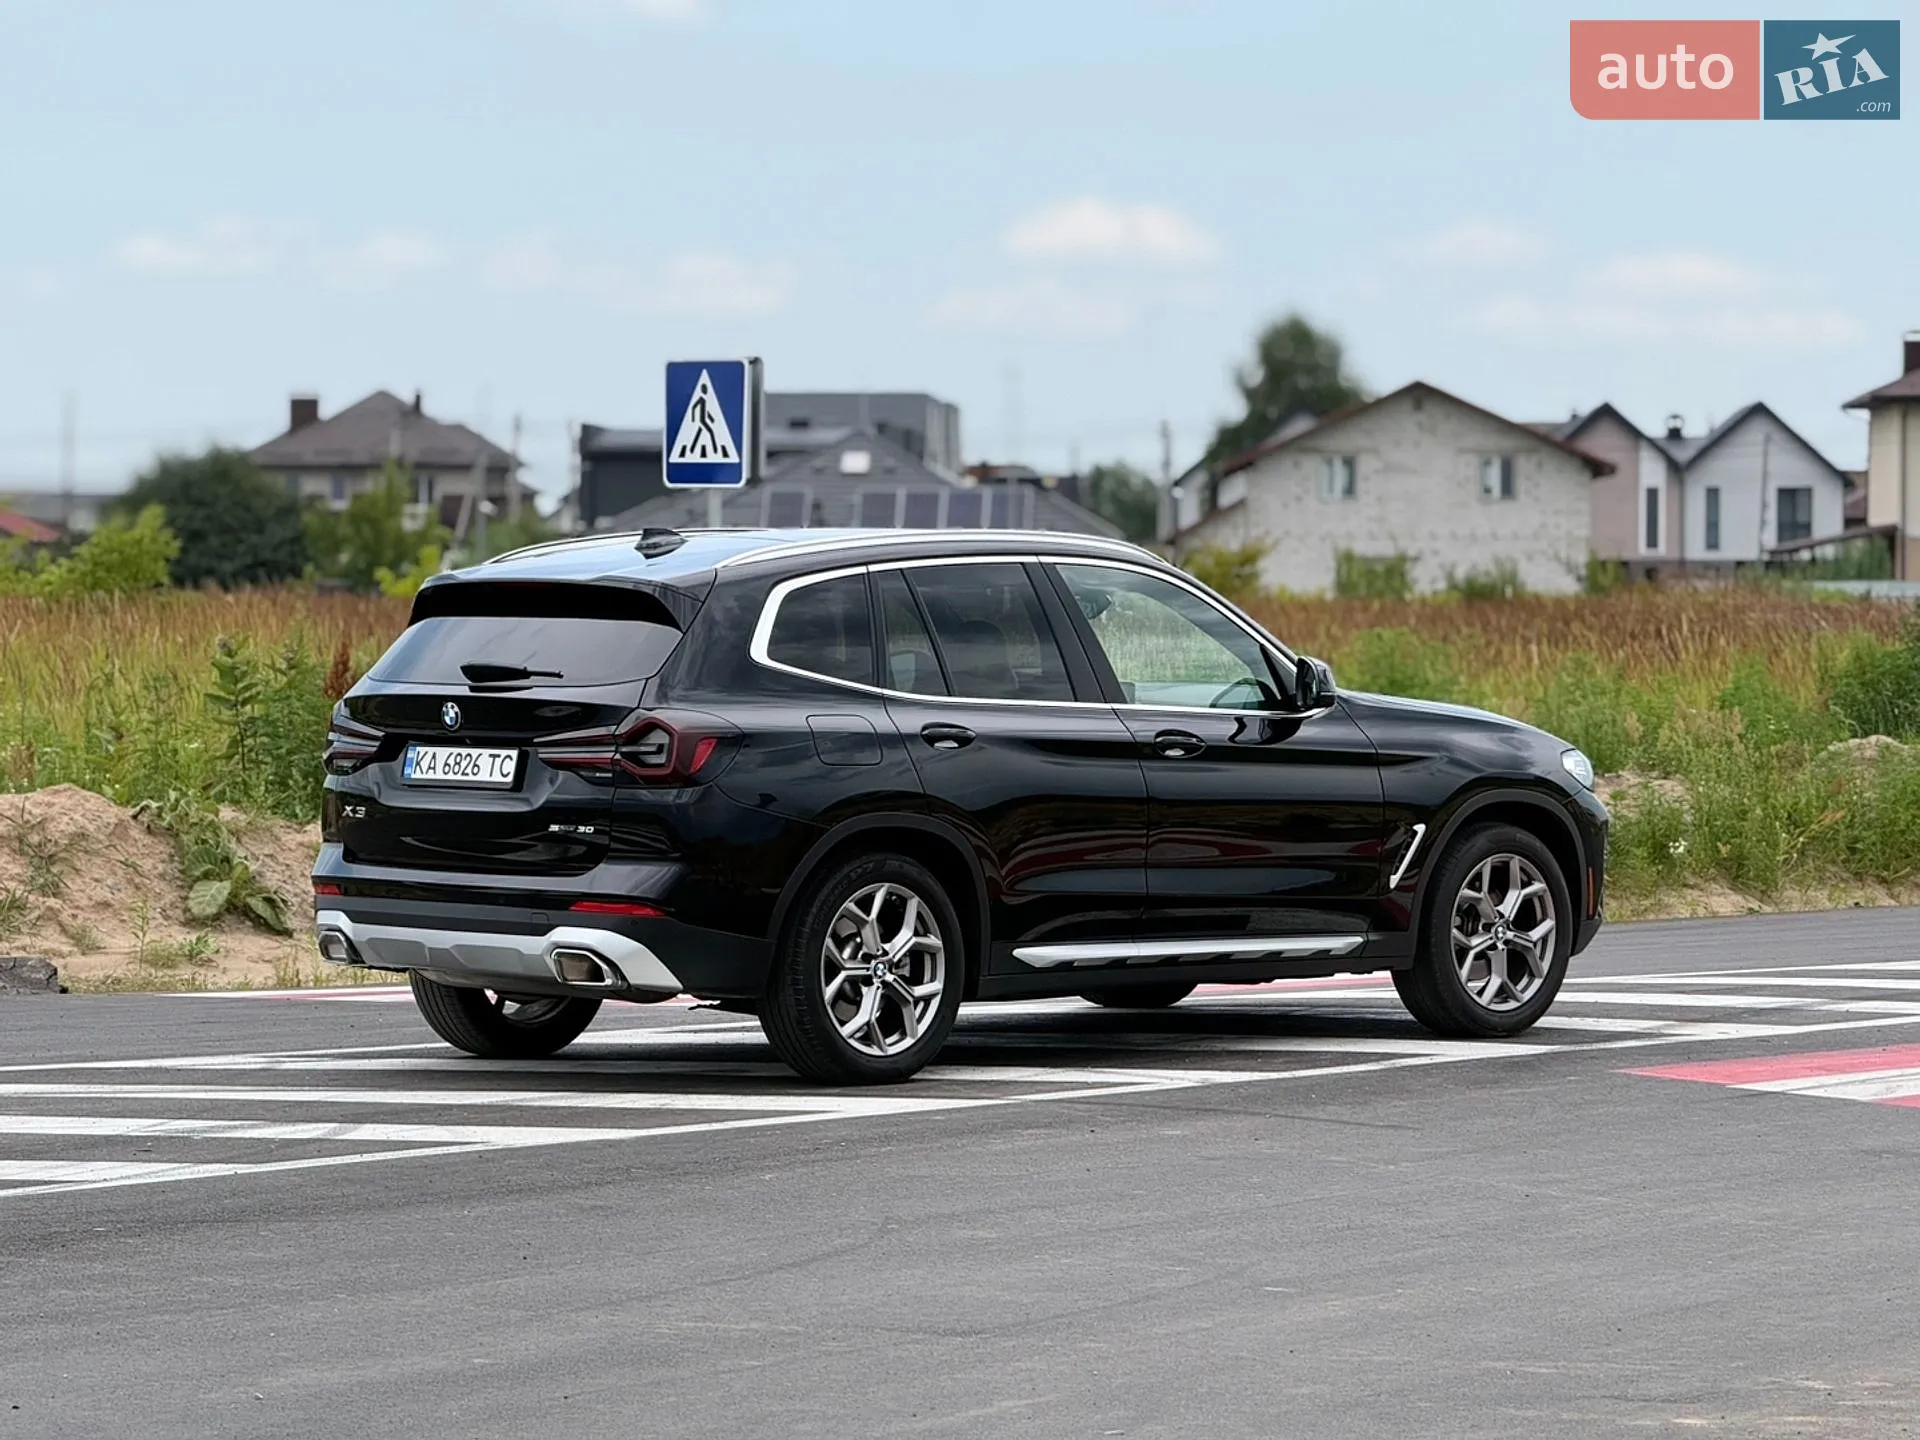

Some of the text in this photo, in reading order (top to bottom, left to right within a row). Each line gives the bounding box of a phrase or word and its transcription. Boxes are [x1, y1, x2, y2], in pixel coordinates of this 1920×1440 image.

[413, 750, 514, 778] KA 6826 TC
[341, 805, 366, 818] X3
